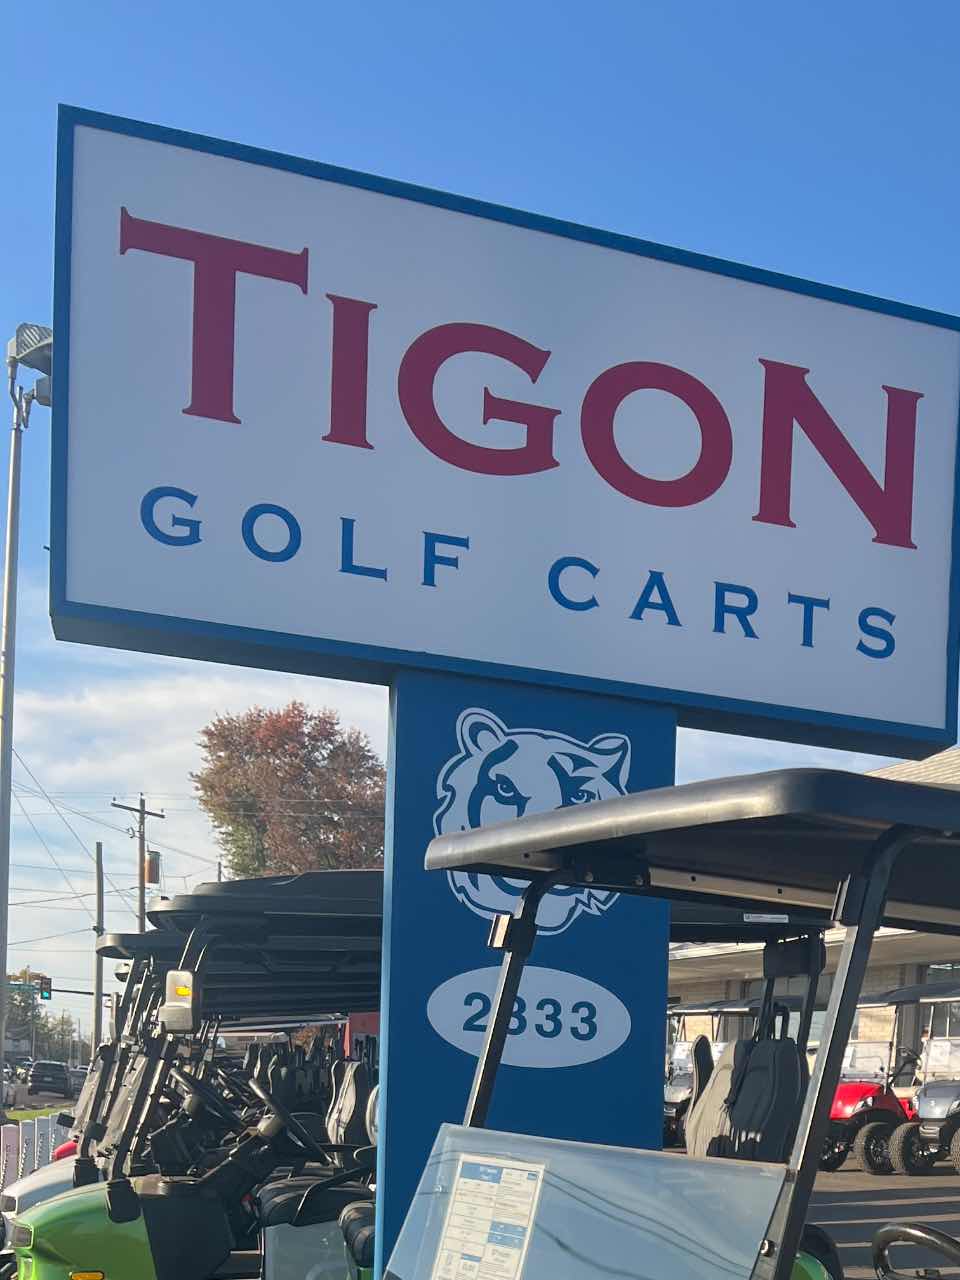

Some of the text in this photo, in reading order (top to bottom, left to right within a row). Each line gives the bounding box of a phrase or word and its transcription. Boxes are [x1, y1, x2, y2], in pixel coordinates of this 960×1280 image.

[119, 206, 924, 550] TIGON
[140, 486, 896, 659] GOLF CARTS
